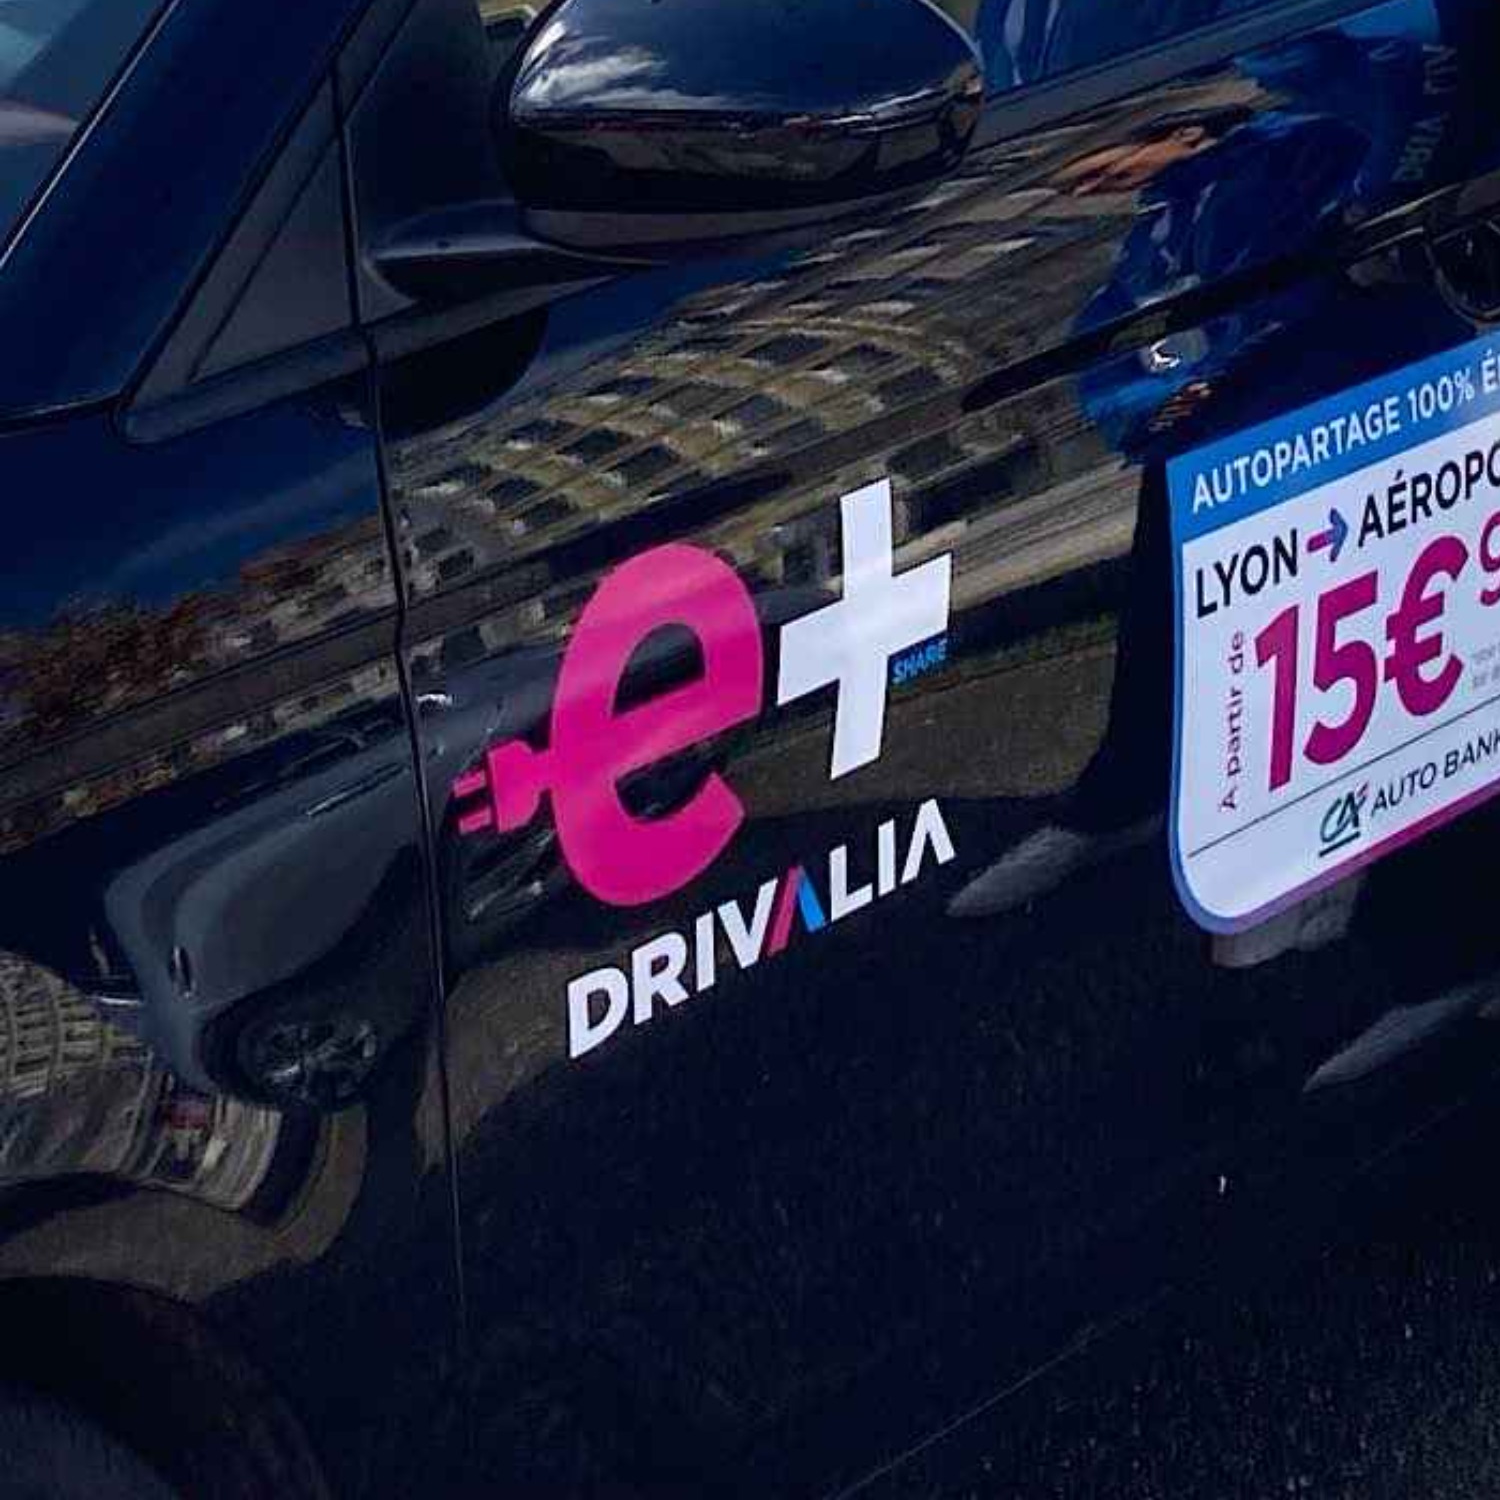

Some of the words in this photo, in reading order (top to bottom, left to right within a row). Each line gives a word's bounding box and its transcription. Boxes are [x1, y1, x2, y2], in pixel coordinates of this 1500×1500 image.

[1192, 396, 1400, 514] AUTOPARTAGE
[1407, 367, 1473, 423] 100%
[1196, 528, 1298, 618] LYON
[892, 637, 948, 685] SHARE
[1228, 630, 1244, 675] de
[1227, 686, 1243, 776] partir
[1371, 762, 1437, 816] AUTO
[566, 797, 957, 1059] DRIVALIA
